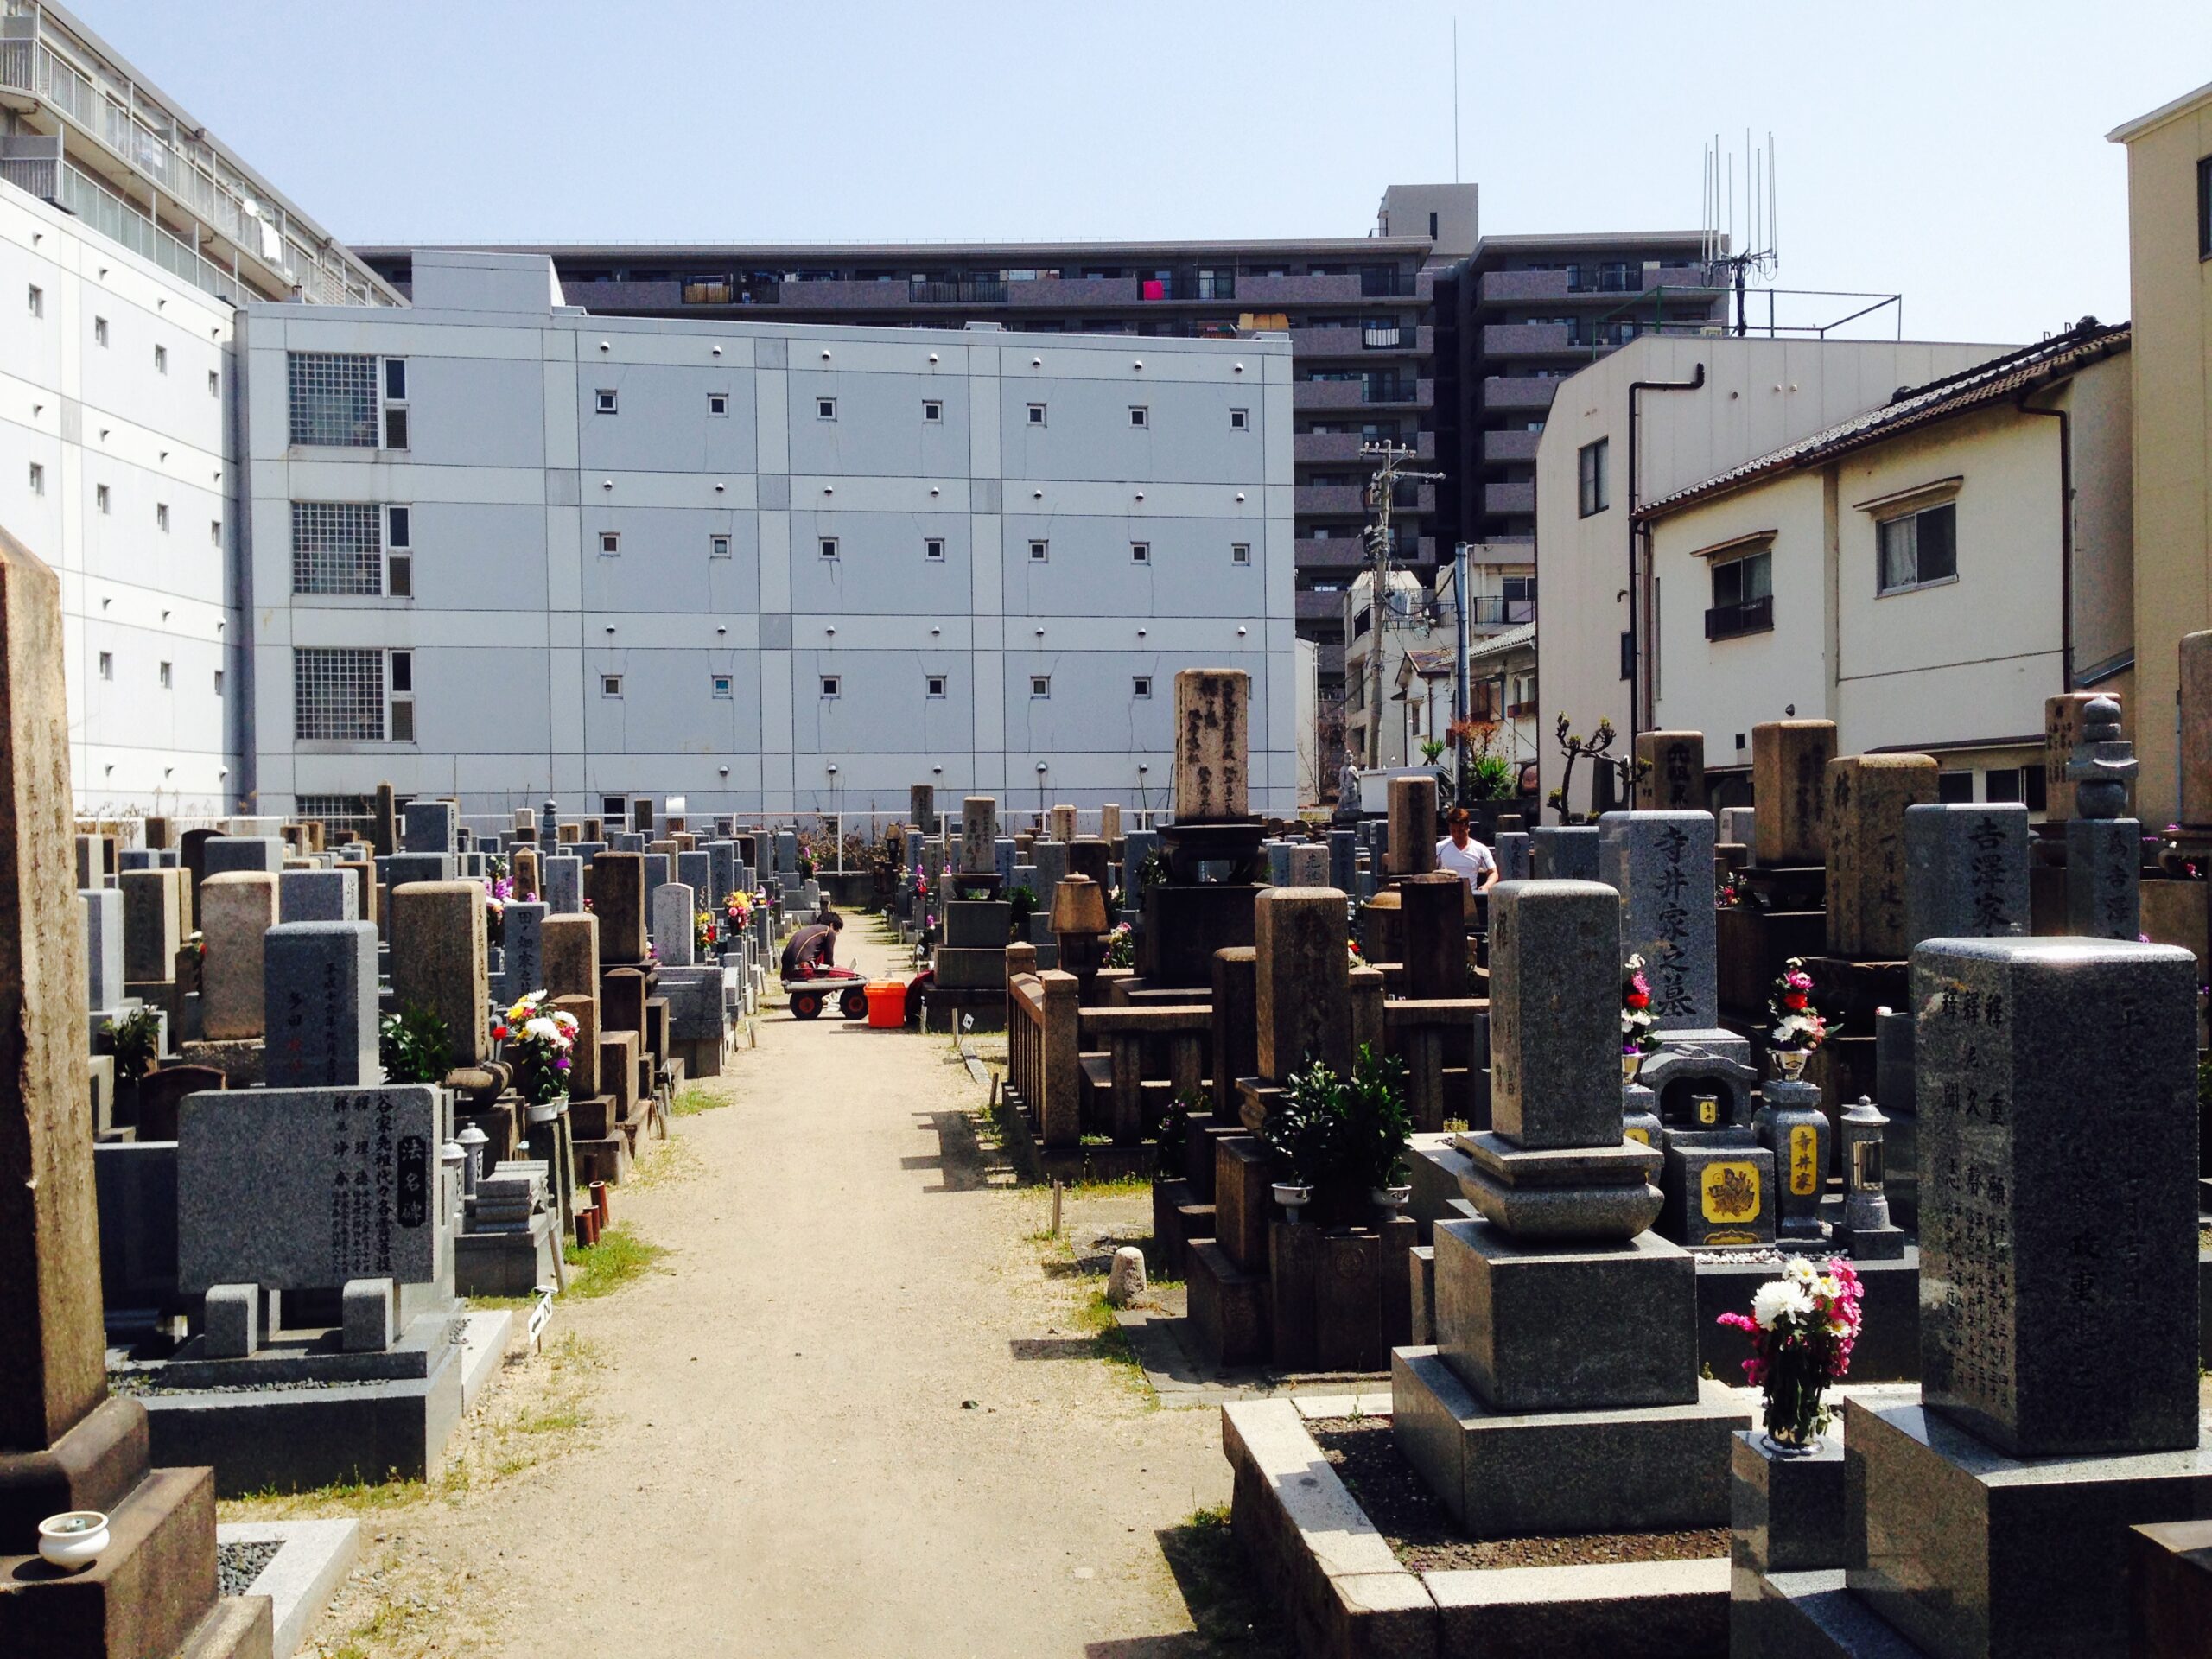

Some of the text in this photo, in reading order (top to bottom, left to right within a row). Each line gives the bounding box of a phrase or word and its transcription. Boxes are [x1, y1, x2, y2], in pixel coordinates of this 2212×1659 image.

[1305, 853, 1321, 887] 先祖
[1654, 825, 1696, 1017] 寺井家之墓
[402, 1139, 423, 1225] 法名碑
[1795, 1131, 1812, 1190] 寺井家
